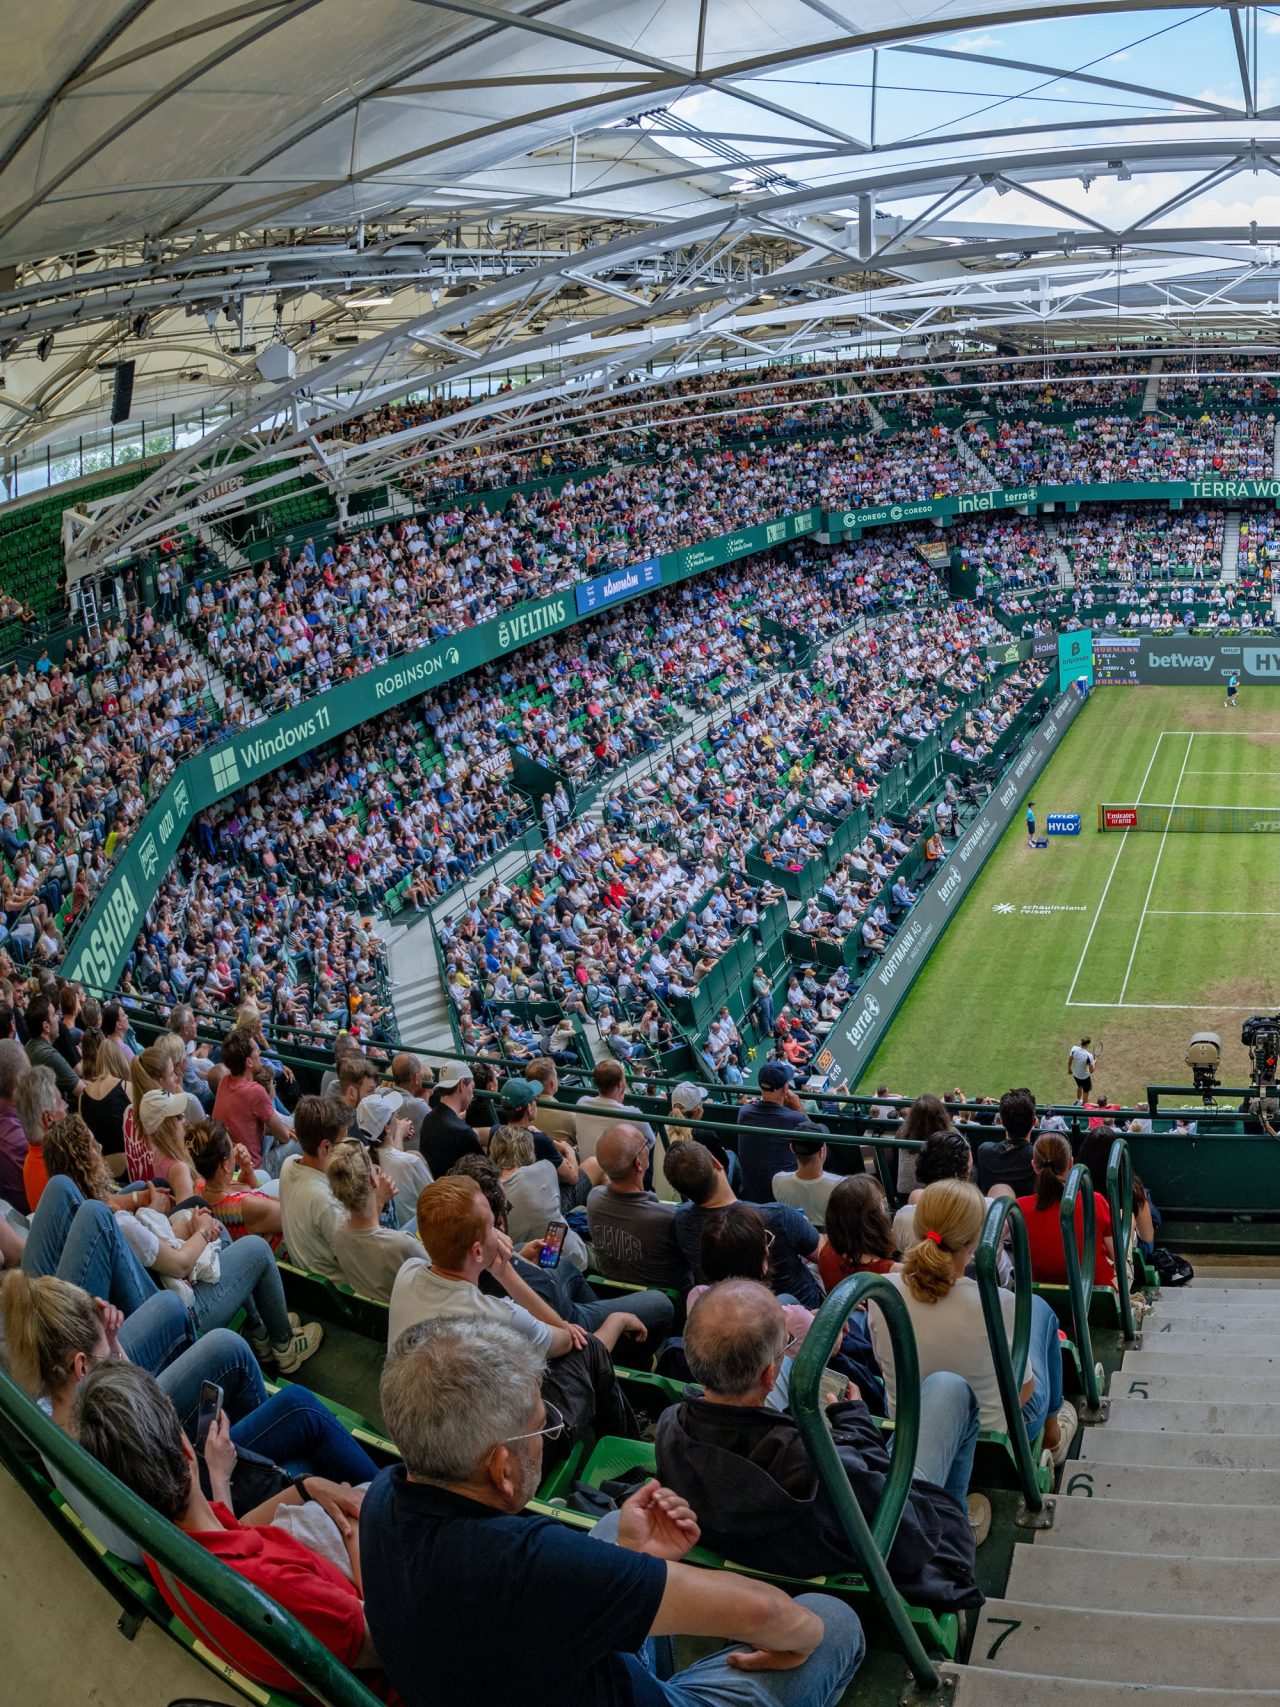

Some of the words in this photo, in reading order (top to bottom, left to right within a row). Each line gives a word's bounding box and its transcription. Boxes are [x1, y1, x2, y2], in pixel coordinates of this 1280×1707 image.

[1004, 492, 1028, 502] terra
[1190, 482, 1248, 497] TERRA
[857, 512, 887, 522] COREGO
[904, 506, 932, 515] COREGO
[509, 599, 565, 642] VELTINS
[1035, 643, 1057, 653] Haier
[1149, 652, 1215, 671] betway
[375, 656, 443, 699] ROBINSON
[240, 717, 316, 769] Windows
[315, 705, 331, 729] 11
[1000, 788, 1015, 806] terra
[1107, 812, 1135, 820] Emirates
[959, 825, 985, 861] WORTMANN
[937, 876, 956, 902] terra
[879, 933, 914, 986] WORTMANN
[911, 921, 922, 938] AG
[845, 1008, 871, 1047] terra
[830, 1064, 842, 1081] 0:19
[1128, 1381, 1149, 1400] 5
[1066, 1473, 1095, 1498] 6
[550, 1509, 561, 1517] 33
[986, 1617, 1022, 1660] 7
[224, 1665, 235, 1677] 34
